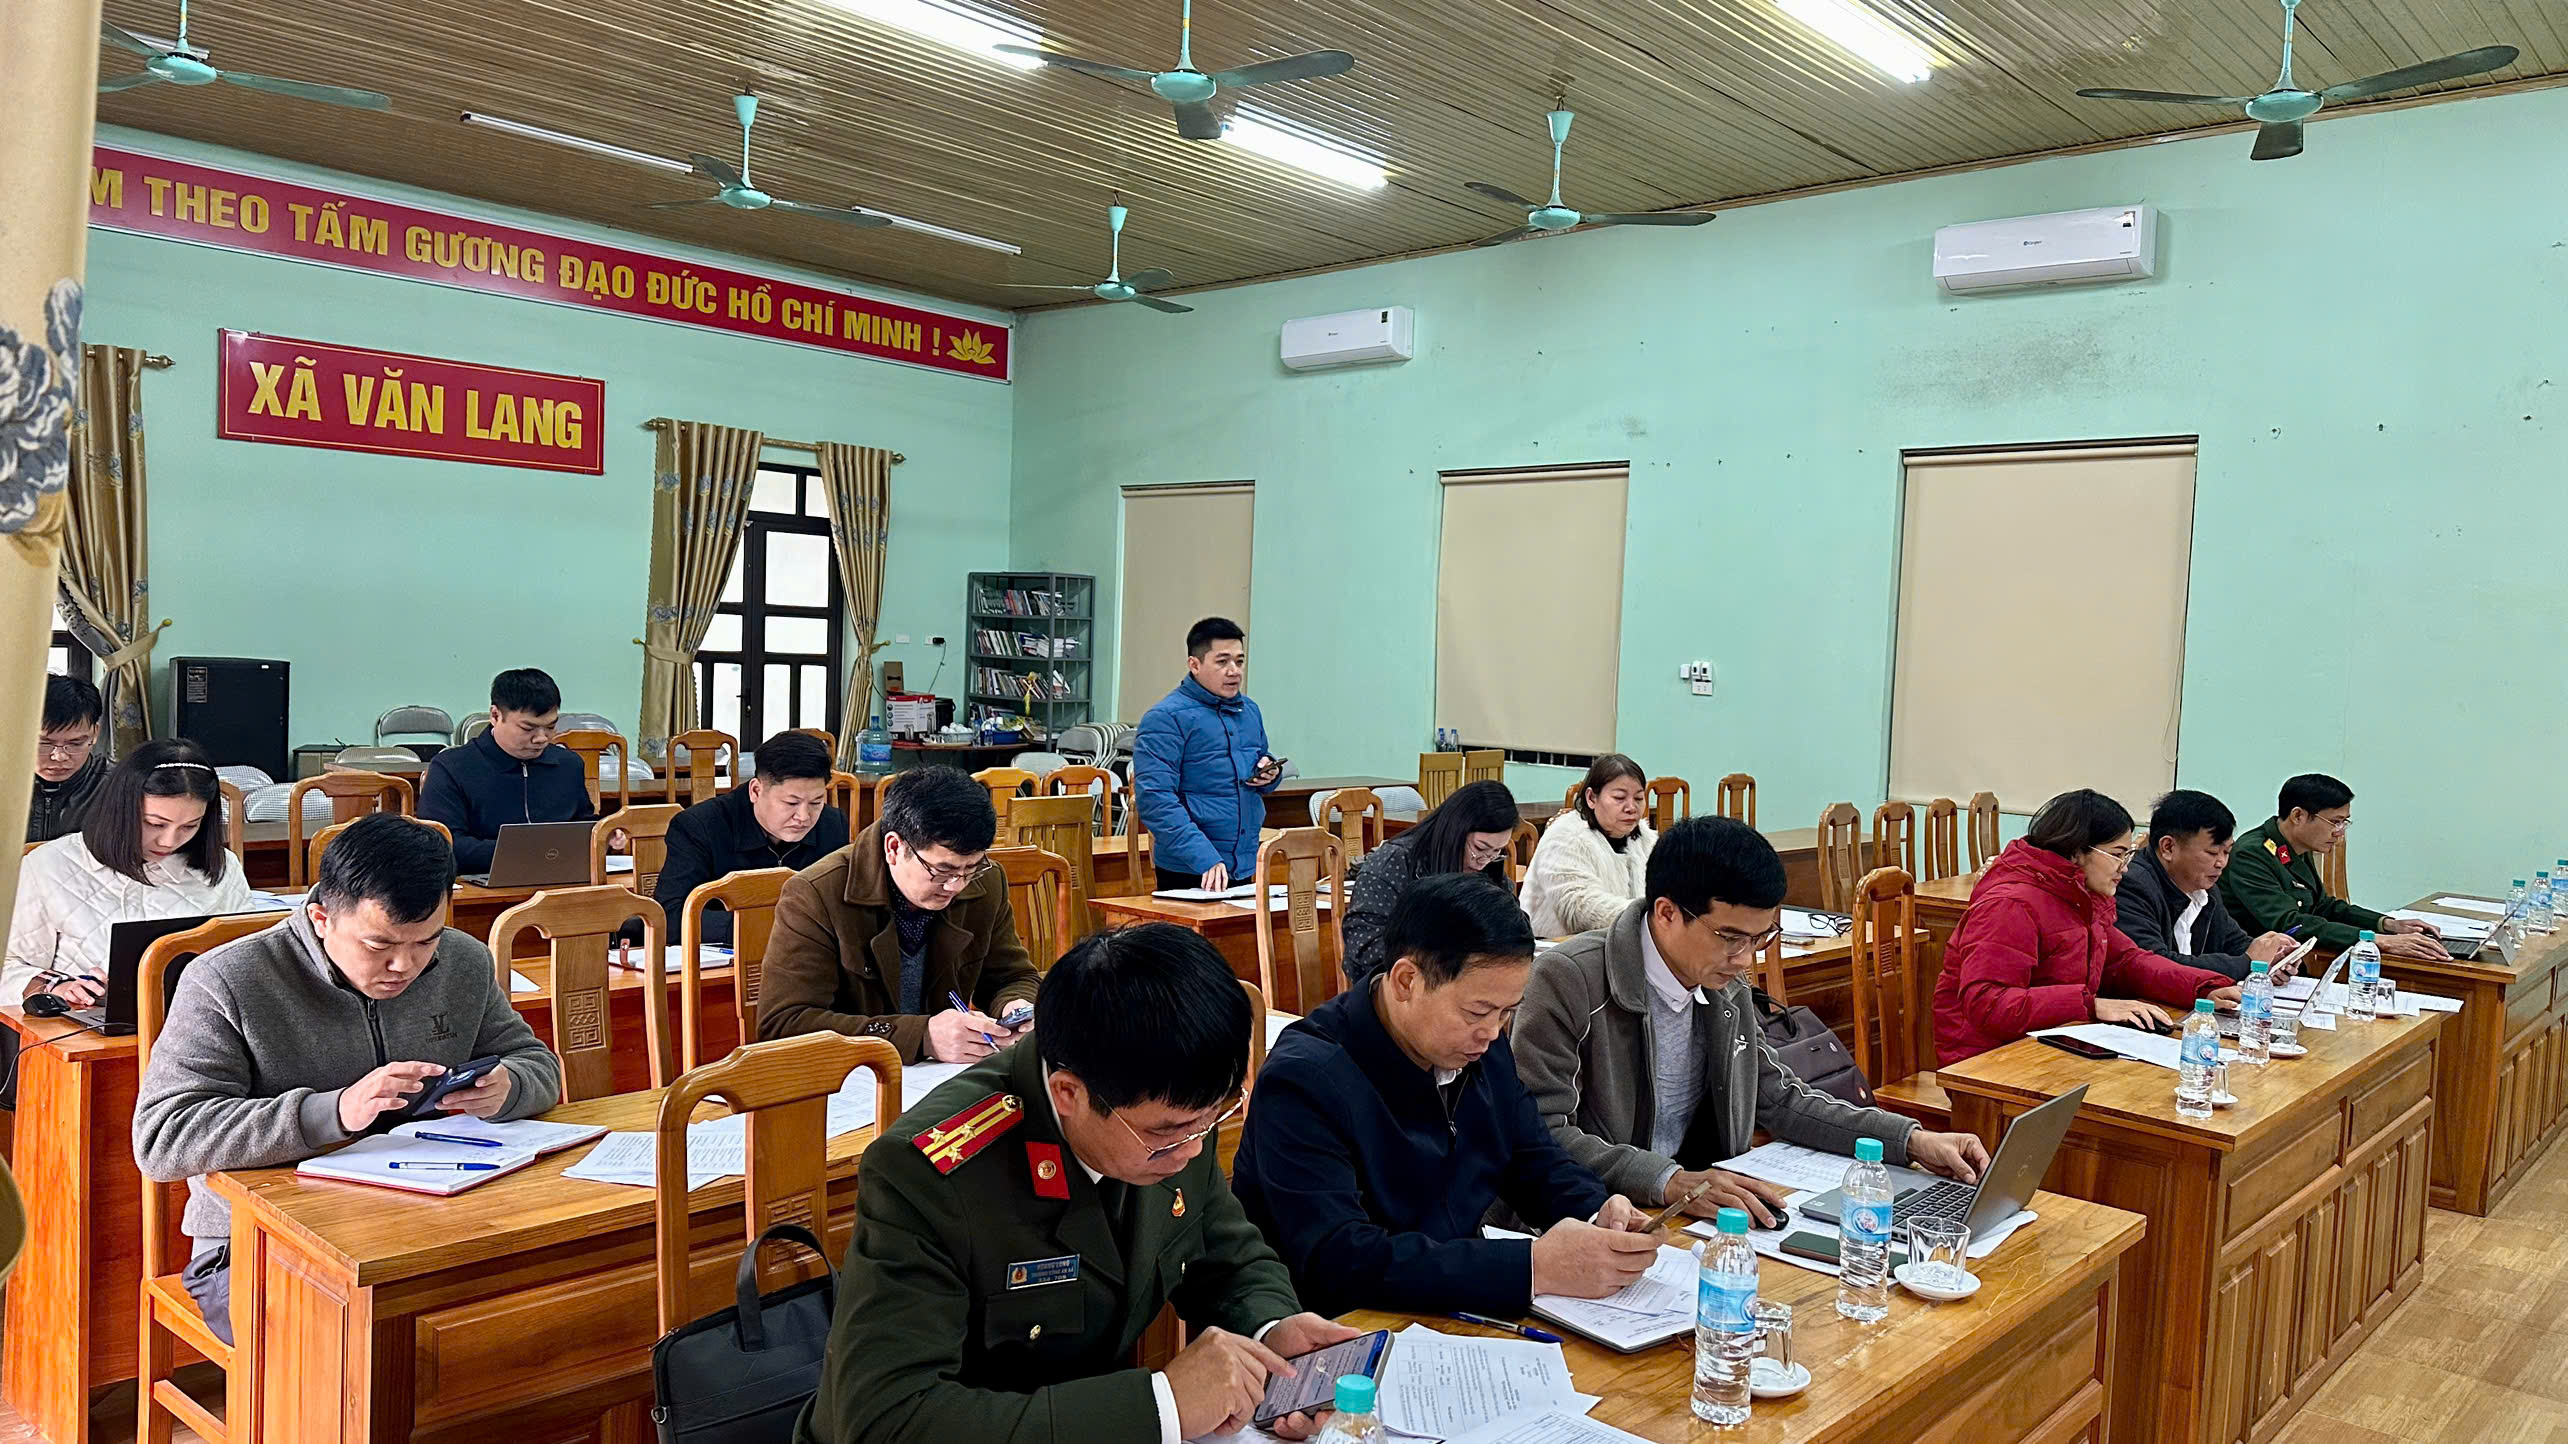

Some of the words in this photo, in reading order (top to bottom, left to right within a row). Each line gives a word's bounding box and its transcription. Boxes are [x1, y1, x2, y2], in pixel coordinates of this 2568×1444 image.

[144, 175, 270, 234] THEO
[287, 200, 389, 256] TẤM
[405, 226, 545, 284] GƯƠNG
[558, 254, 635, 301] ĐẠO
[646, 268, 717, 313] ĐỨC
[727, 283, 773, 324] HỒ
[782, 298, 835, 337] CHÍ
[844, 311, 923, 353] MINH
[247, 356, 323, 422] XÃ
[342, 367, 445, 436] VĂN
[465, 389, 584, 450] LANG
